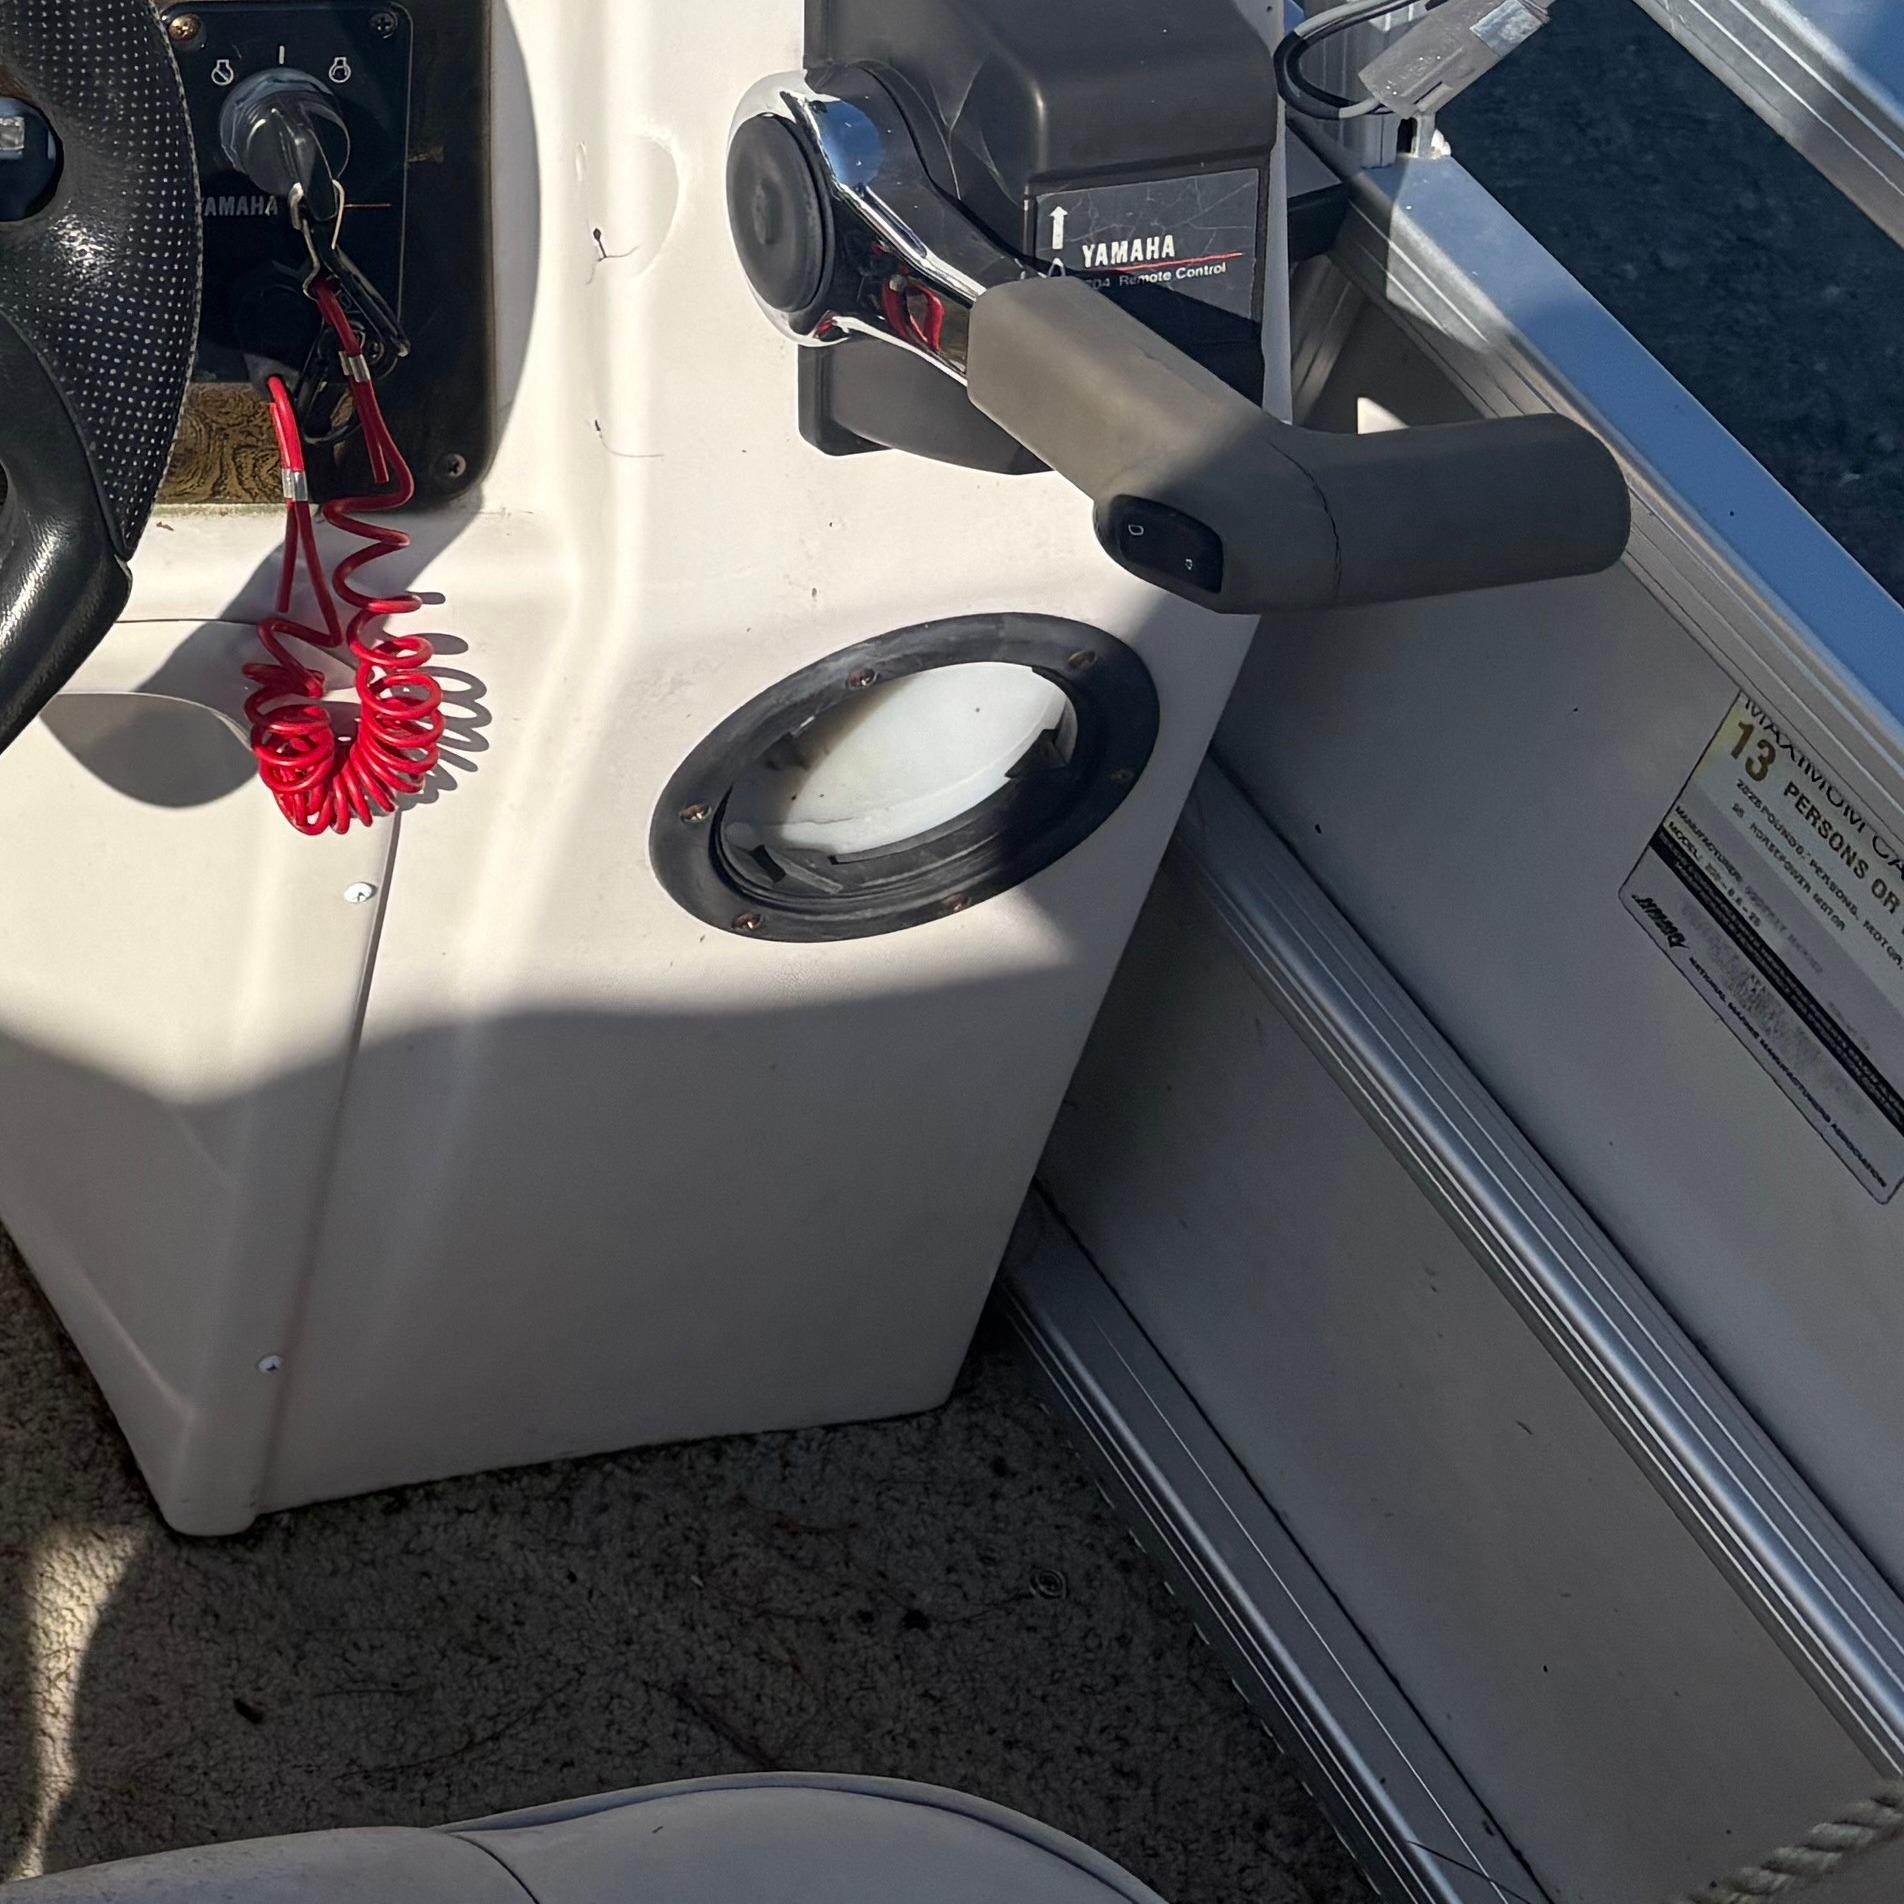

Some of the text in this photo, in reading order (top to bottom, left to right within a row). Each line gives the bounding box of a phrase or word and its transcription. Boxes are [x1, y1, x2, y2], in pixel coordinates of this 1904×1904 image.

[202, 195, 278, 217] AMAHA
[1082, 234, 1175, 268] YAMAHA
[1119, 269, 1172, 287] Remote
[1175, 261, 1228, 280] Control
[1725, 720, 1901, 915] 13 PERSONS OR
